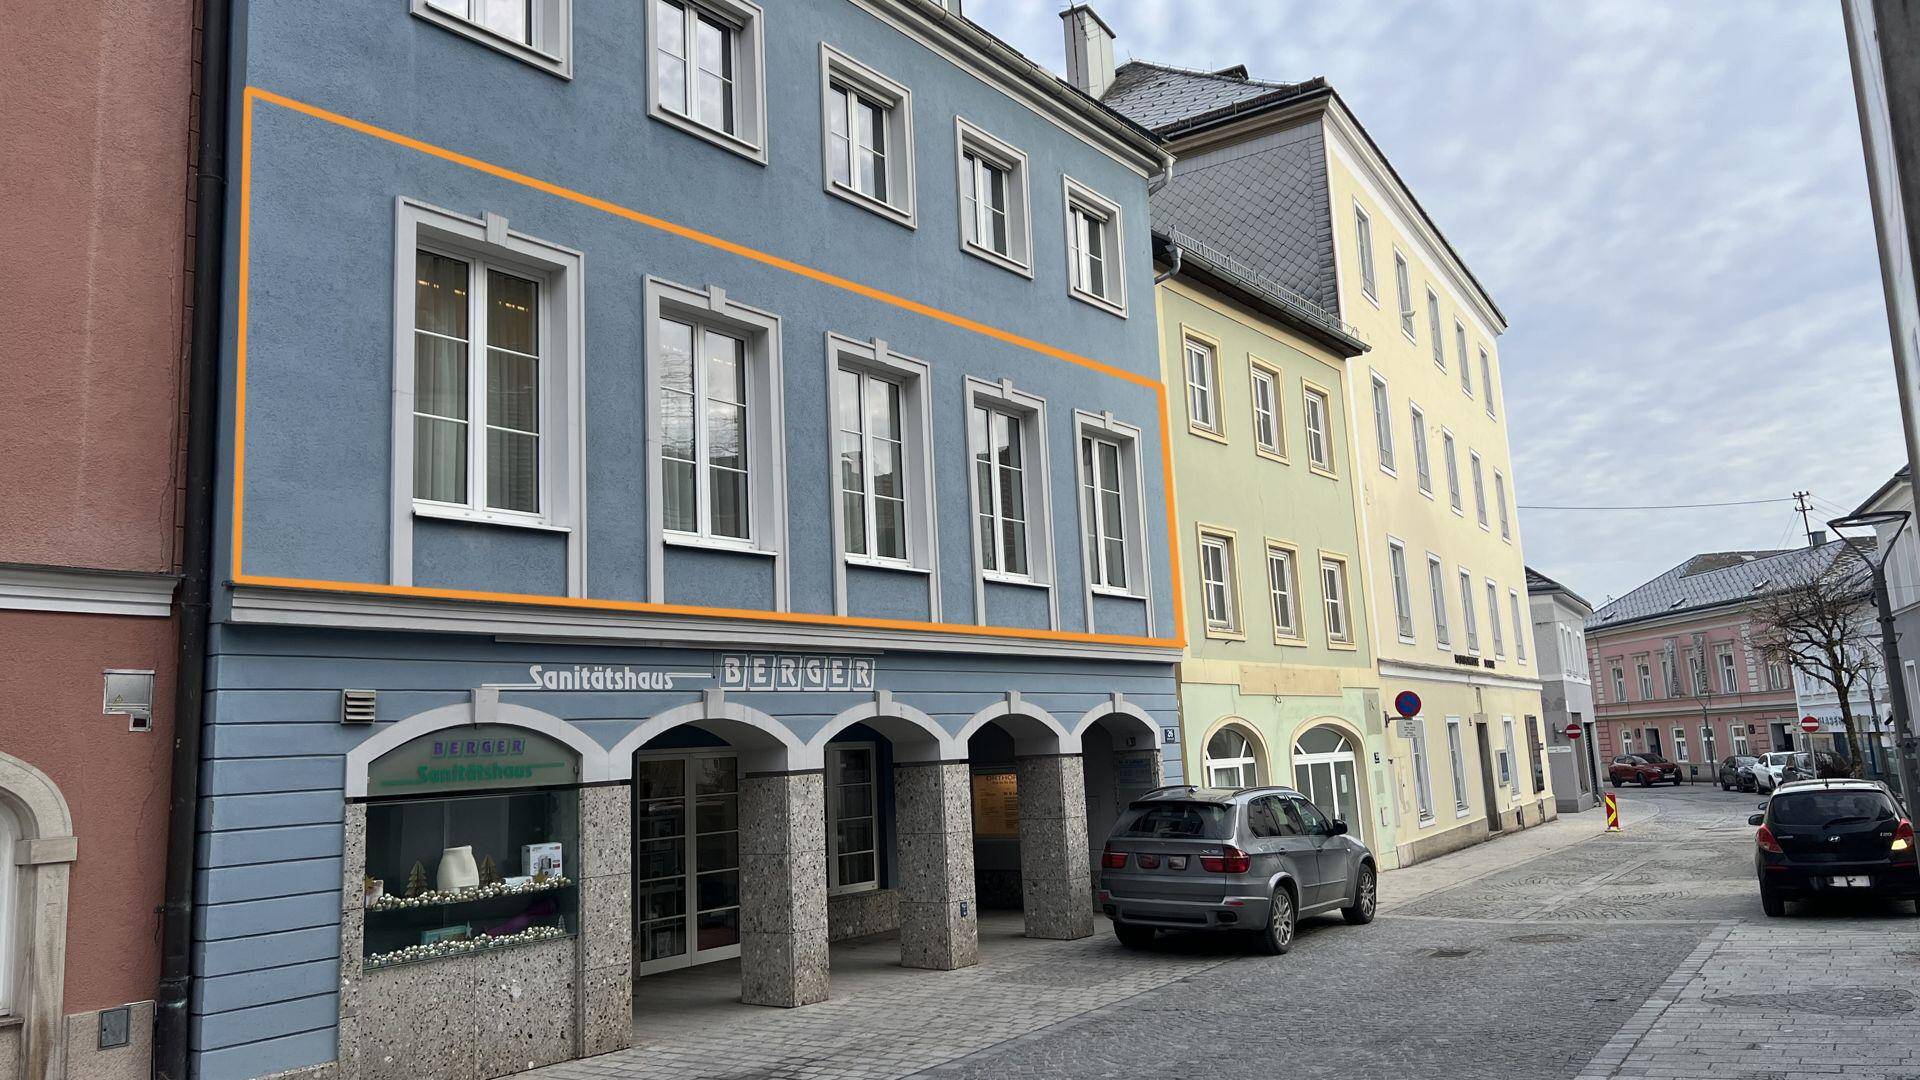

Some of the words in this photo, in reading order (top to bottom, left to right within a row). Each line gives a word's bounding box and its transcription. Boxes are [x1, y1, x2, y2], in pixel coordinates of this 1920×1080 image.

[529, 664, 674, 691] Sanitätshaus
[723, 656, 871, 689] BERGER
[433, 739, 523, 756] BERGER
[417, 762, 533, 784] Sanitätshaus
